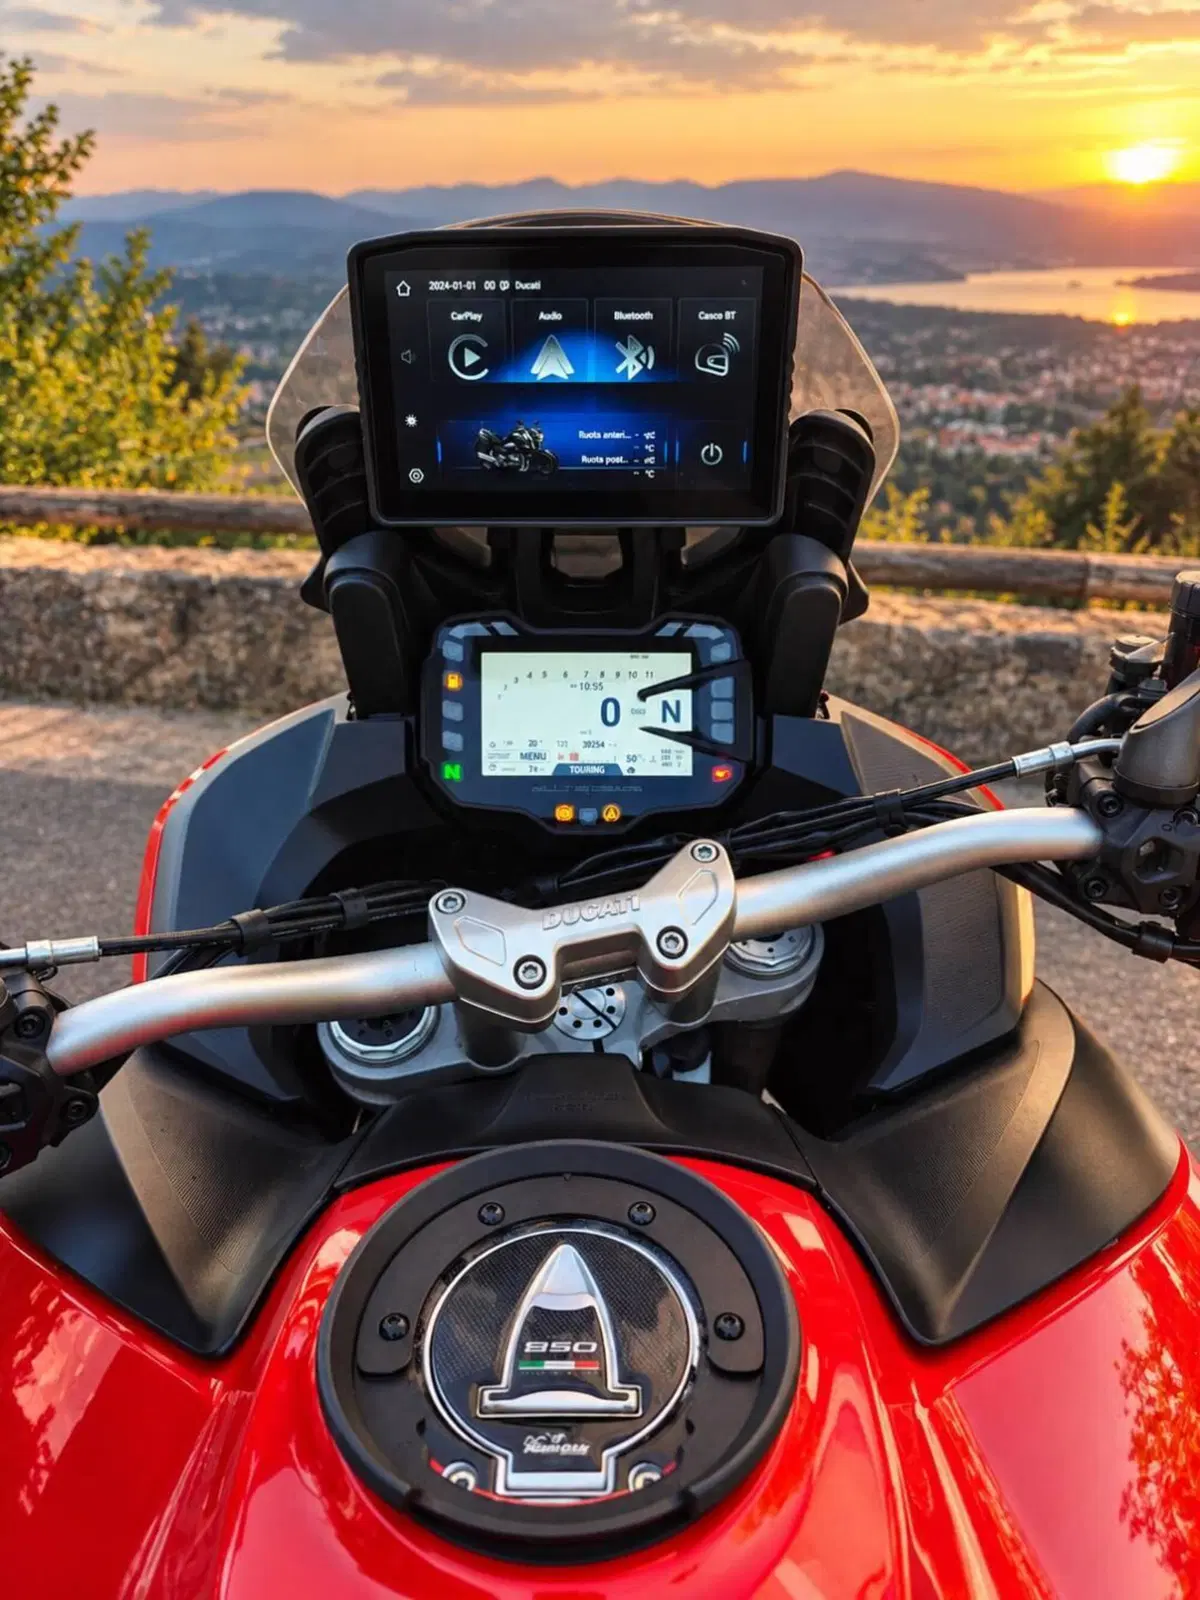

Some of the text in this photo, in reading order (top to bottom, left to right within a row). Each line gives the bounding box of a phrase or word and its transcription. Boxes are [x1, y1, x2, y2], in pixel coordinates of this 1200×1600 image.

[428, 281, 476, 291] 2024-01-01
[515, 281, 541, 290] Ducati
[450, 311, 483, 322] CarPlay
[538, 311, 563, 320] Audio
[614, 311, 654, 320] Bluetooth
[698, 311, 736, 320] Casco BT
[578, 430, 601, 439] Ruota
[582, 456, 604, 464] Ruota
[563, 670, 568, 678] 6
[601, 697, 620, 727] 0
[662, 700, 680, 724] N
[520, 752, 546, 760] MENU
[626, 754, 637, 762] 50
[569, 766, 605, 774] TOURING
[542, 894, 640, 931] DUCATI
[524, 1342, 598, 1352] 850
